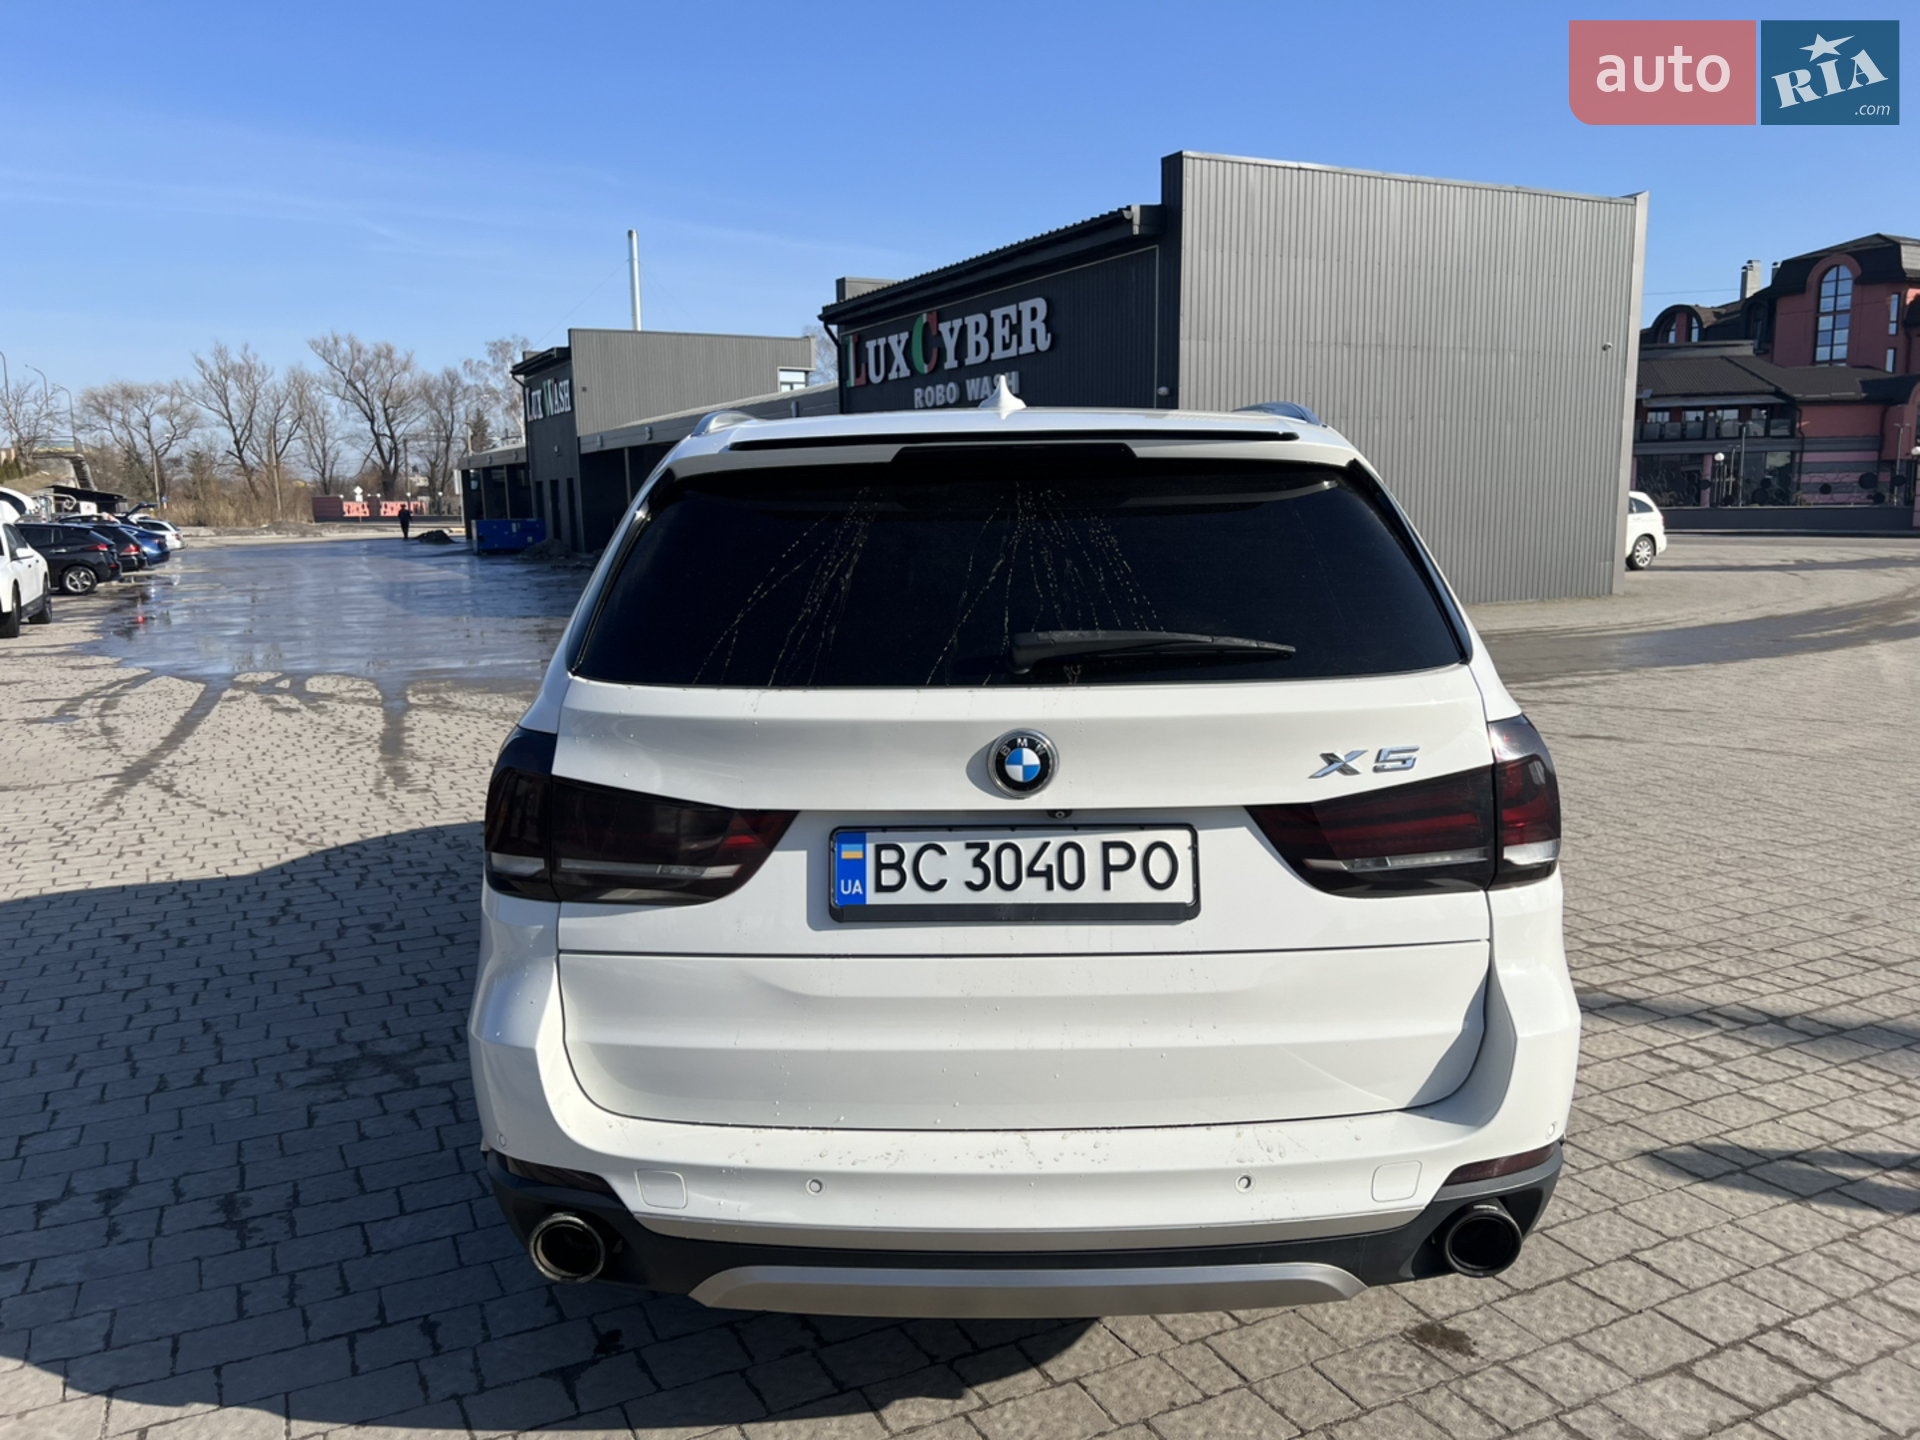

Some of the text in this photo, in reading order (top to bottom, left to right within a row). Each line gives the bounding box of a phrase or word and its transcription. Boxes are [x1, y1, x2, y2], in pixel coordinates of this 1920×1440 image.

[543, 378, 572, 418] WASH
[914, 381, 959, 409] ROBO
[1307, 744, 1421, 779] X5
[874, 840, 1180, 893] BC 3040 PO
[840, 879, 863, 895] UA
